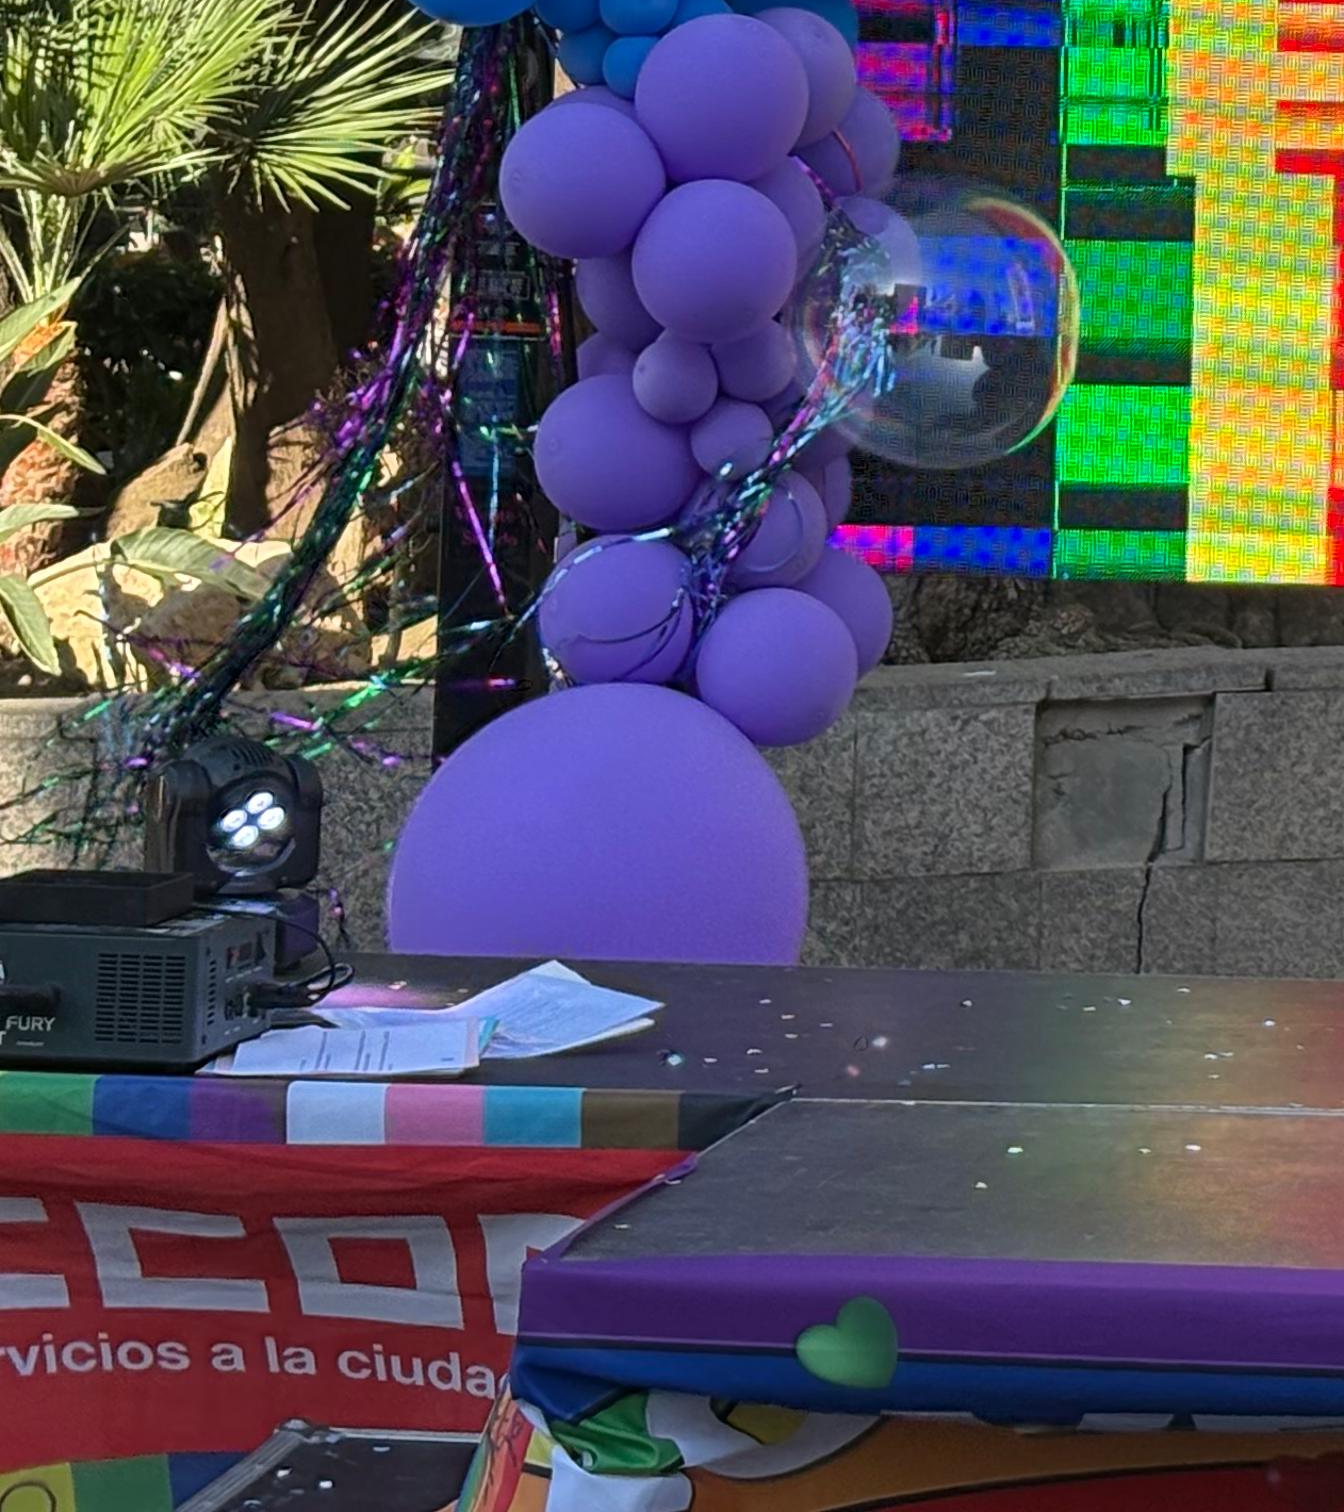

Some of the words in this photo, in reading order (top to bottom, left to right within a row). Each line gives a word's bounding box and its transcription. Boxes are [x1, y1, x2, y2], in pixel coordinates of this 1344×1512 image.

[6, 1015, 56, 1032] FURY
[210, 1342, 245, 1372] a
[265, 1337, 317, 1375] la
